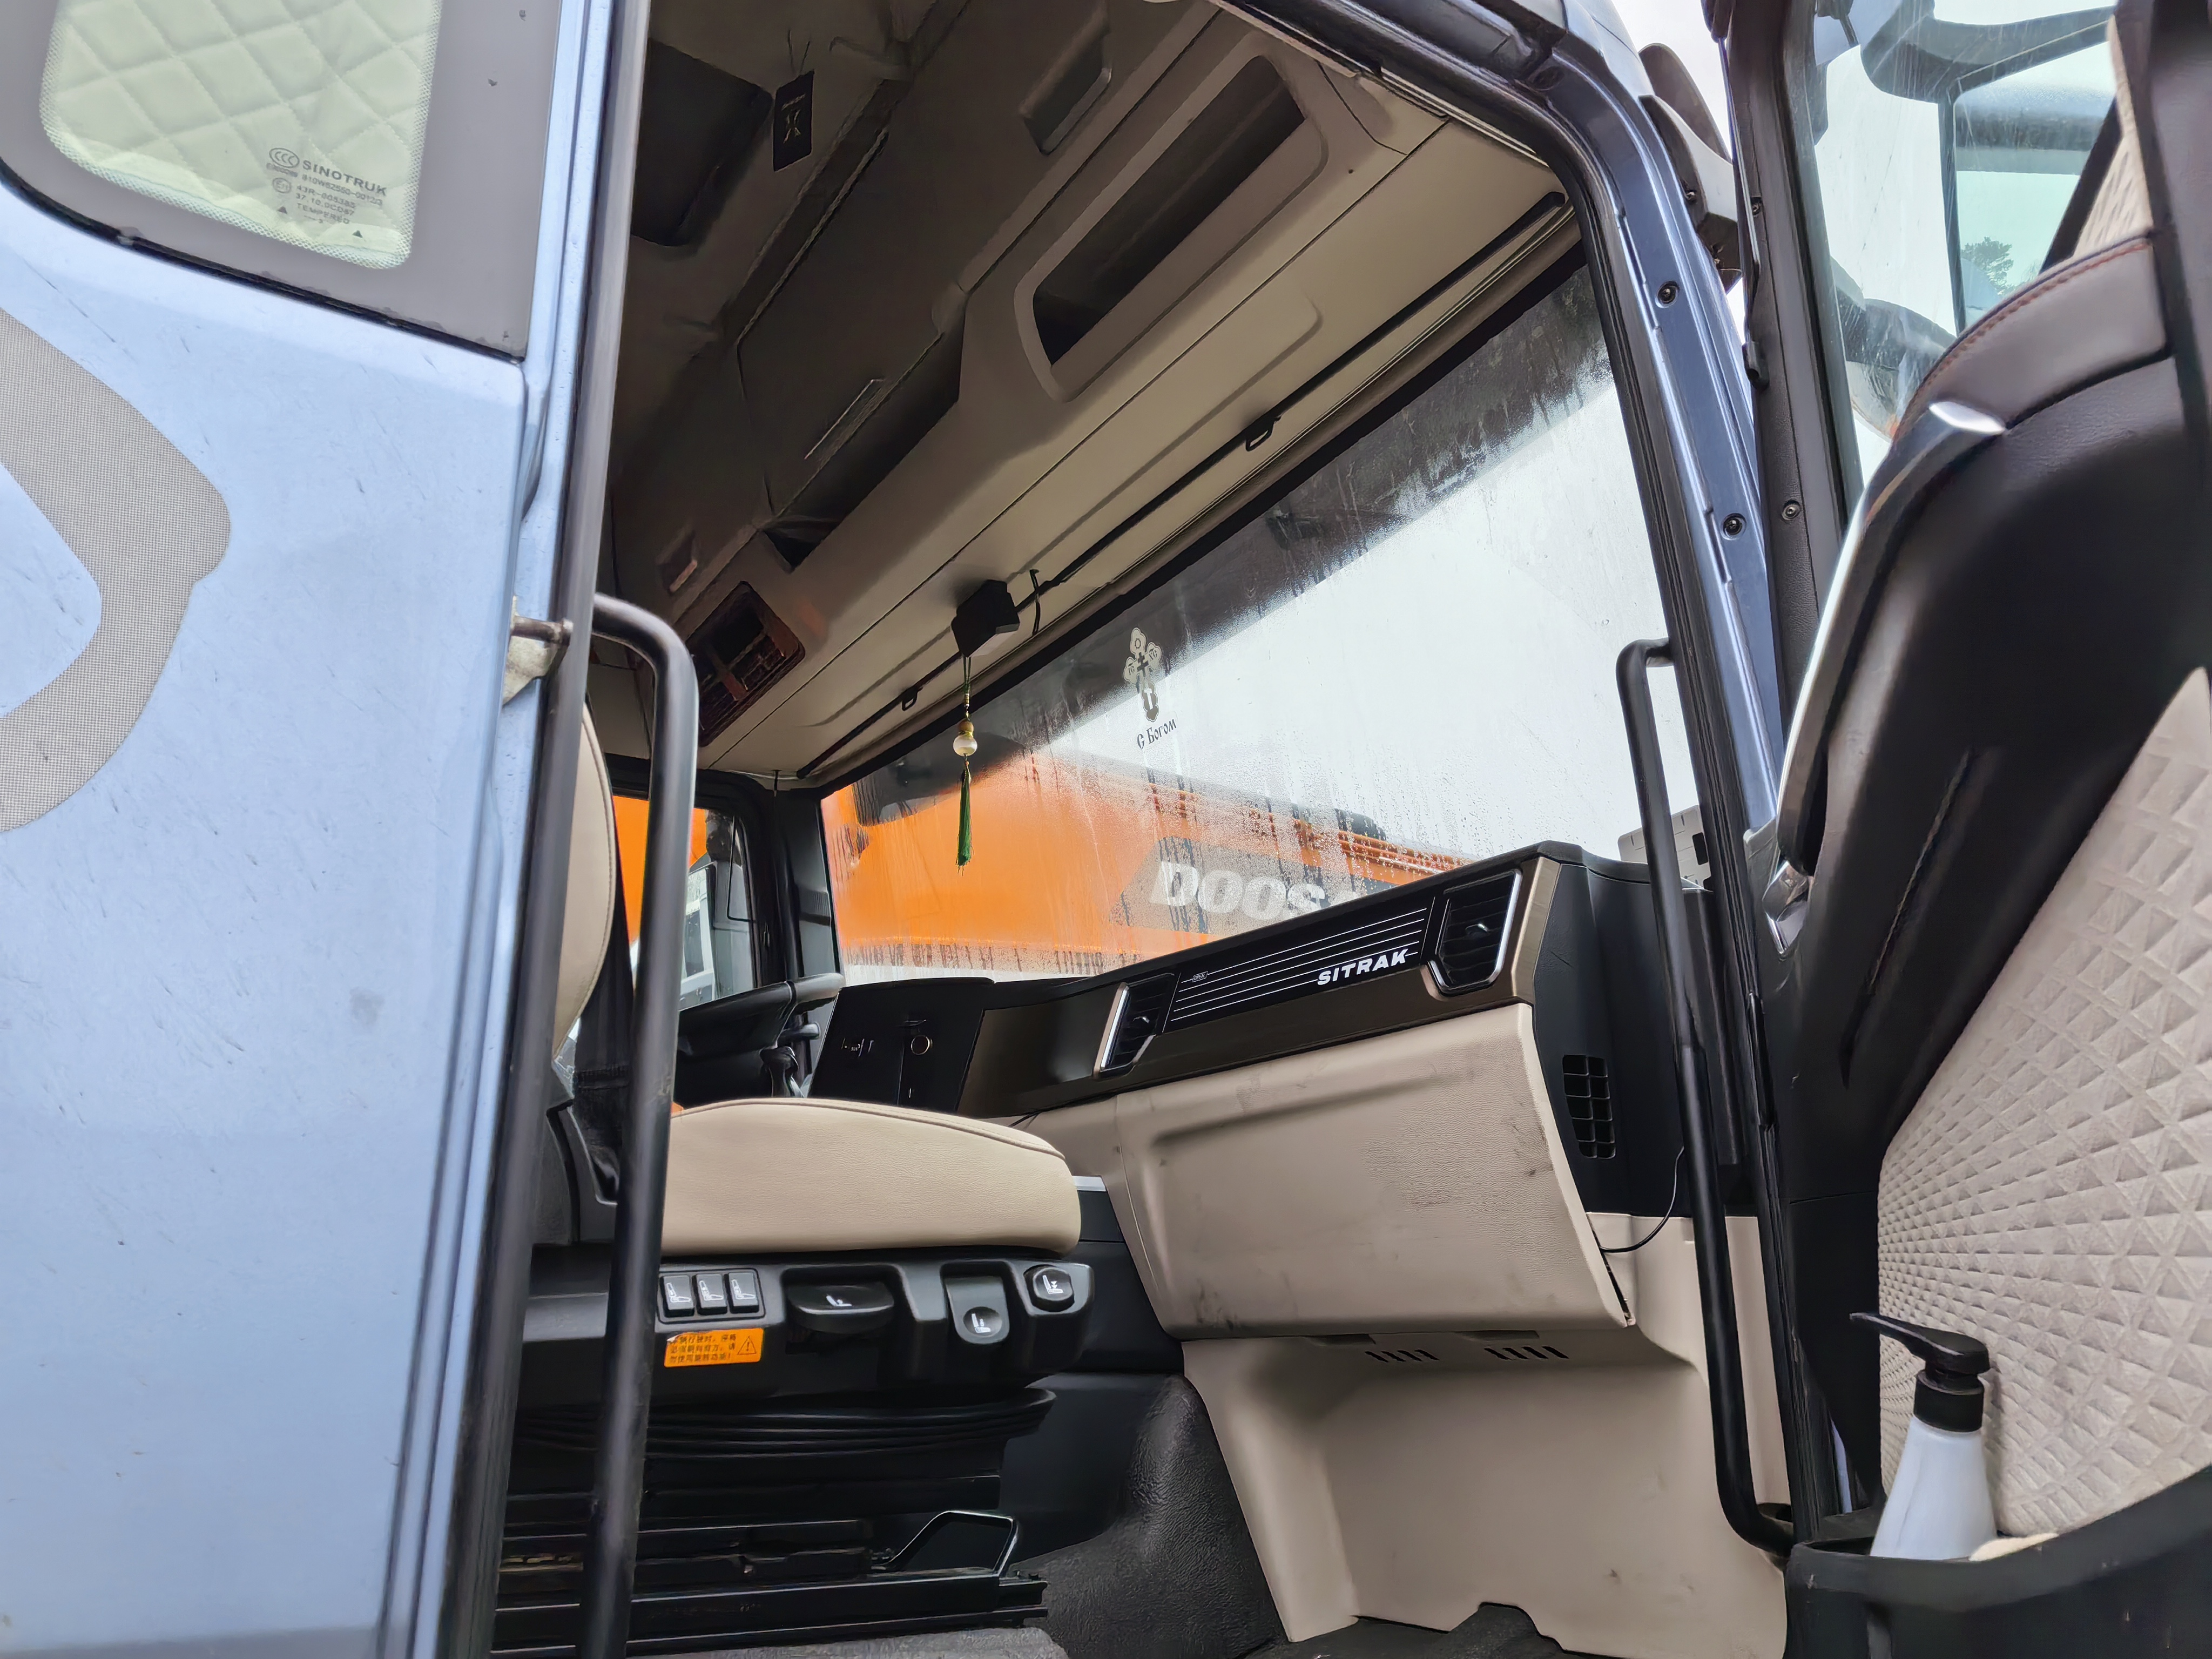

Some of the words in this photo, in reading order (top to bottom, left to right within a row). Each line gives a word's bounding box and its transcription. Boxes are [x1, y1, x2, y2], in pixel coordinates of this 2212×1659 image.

[302, 160, 387, 196] SINOTRUK
[1147, 718, 1177, 745] Богом
[1317, 948, 1409, 986] SITRAK
